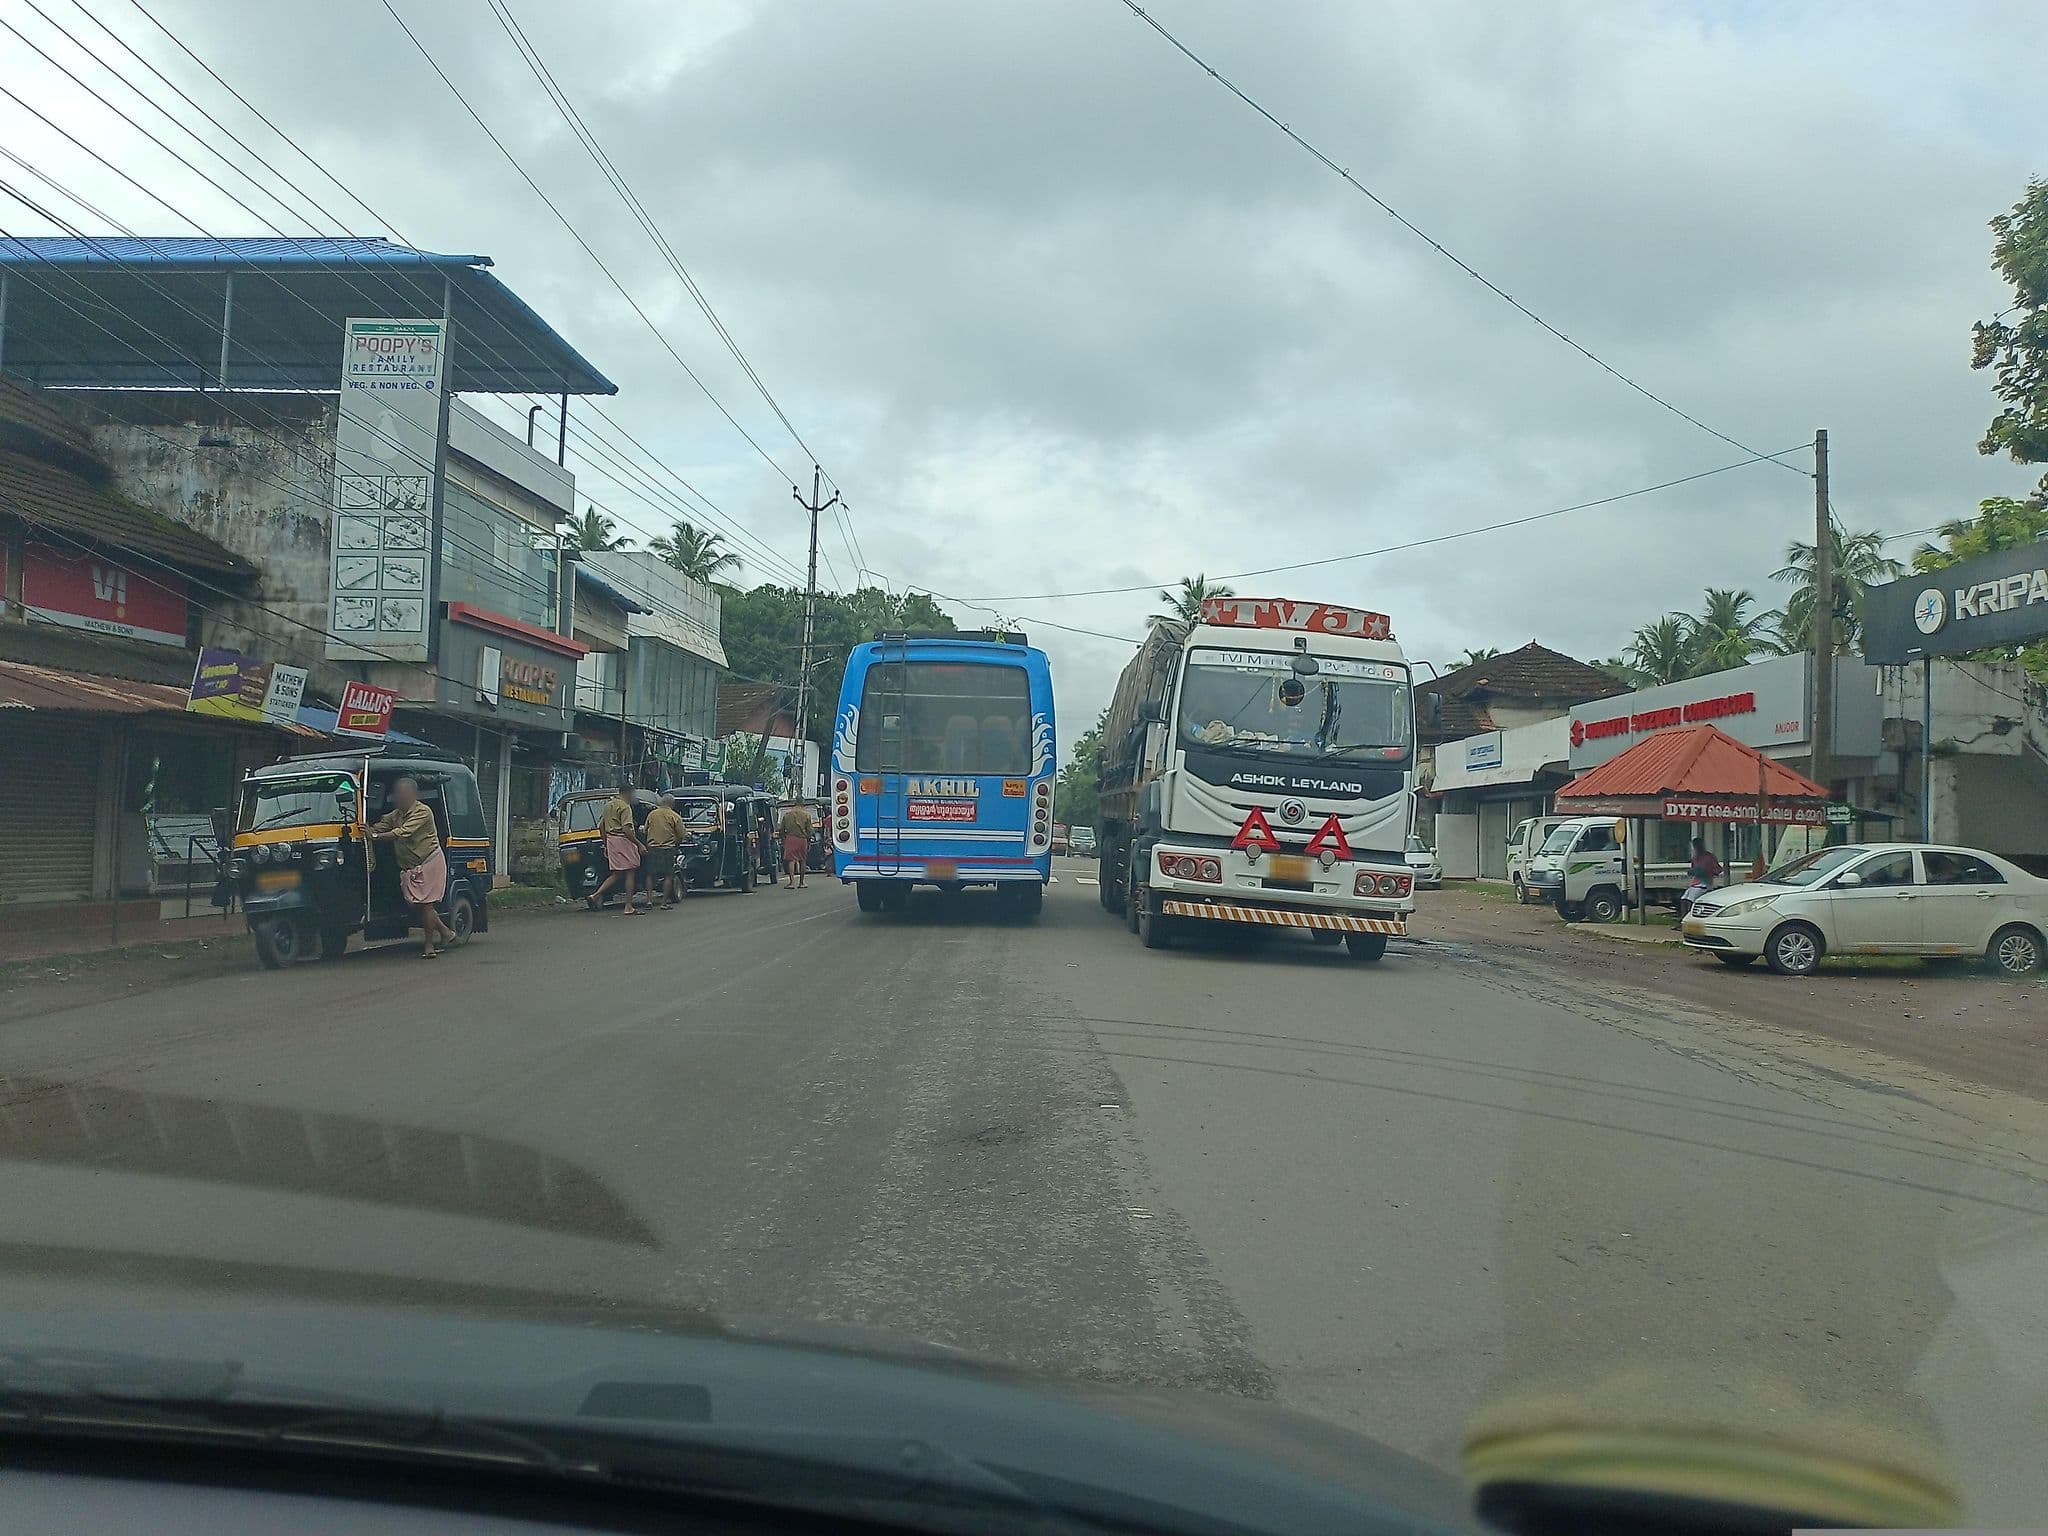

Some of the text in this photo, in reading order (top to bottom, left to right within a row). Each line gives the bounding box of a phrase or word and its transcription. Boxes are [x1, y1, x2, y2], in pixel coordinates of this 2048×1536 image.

[355, 336, 432, 353] POOPY'S
[352, 363, 433, 373] RESTAURANT
[348, 380, 420, 390] VEG. & NON VEG.
[1222, 600, 1369, 635] TVJ
[84, 619, 134, 636] MATHEW & SONS
[1219, 653, 1242, 662] TVJ
[1354, 664, 1380, 676] td.
[275, 671, 304, 686] MATHEW
[275, 684, 299, 698] & SONS
[347, 688, 392, 714] LALLU'S
[904, 779, 980, 797] AKHIL
[1231, 773, 1363, 793] ASHOK LEYLAND
[1666, 803, 1708, 817] DYFI
